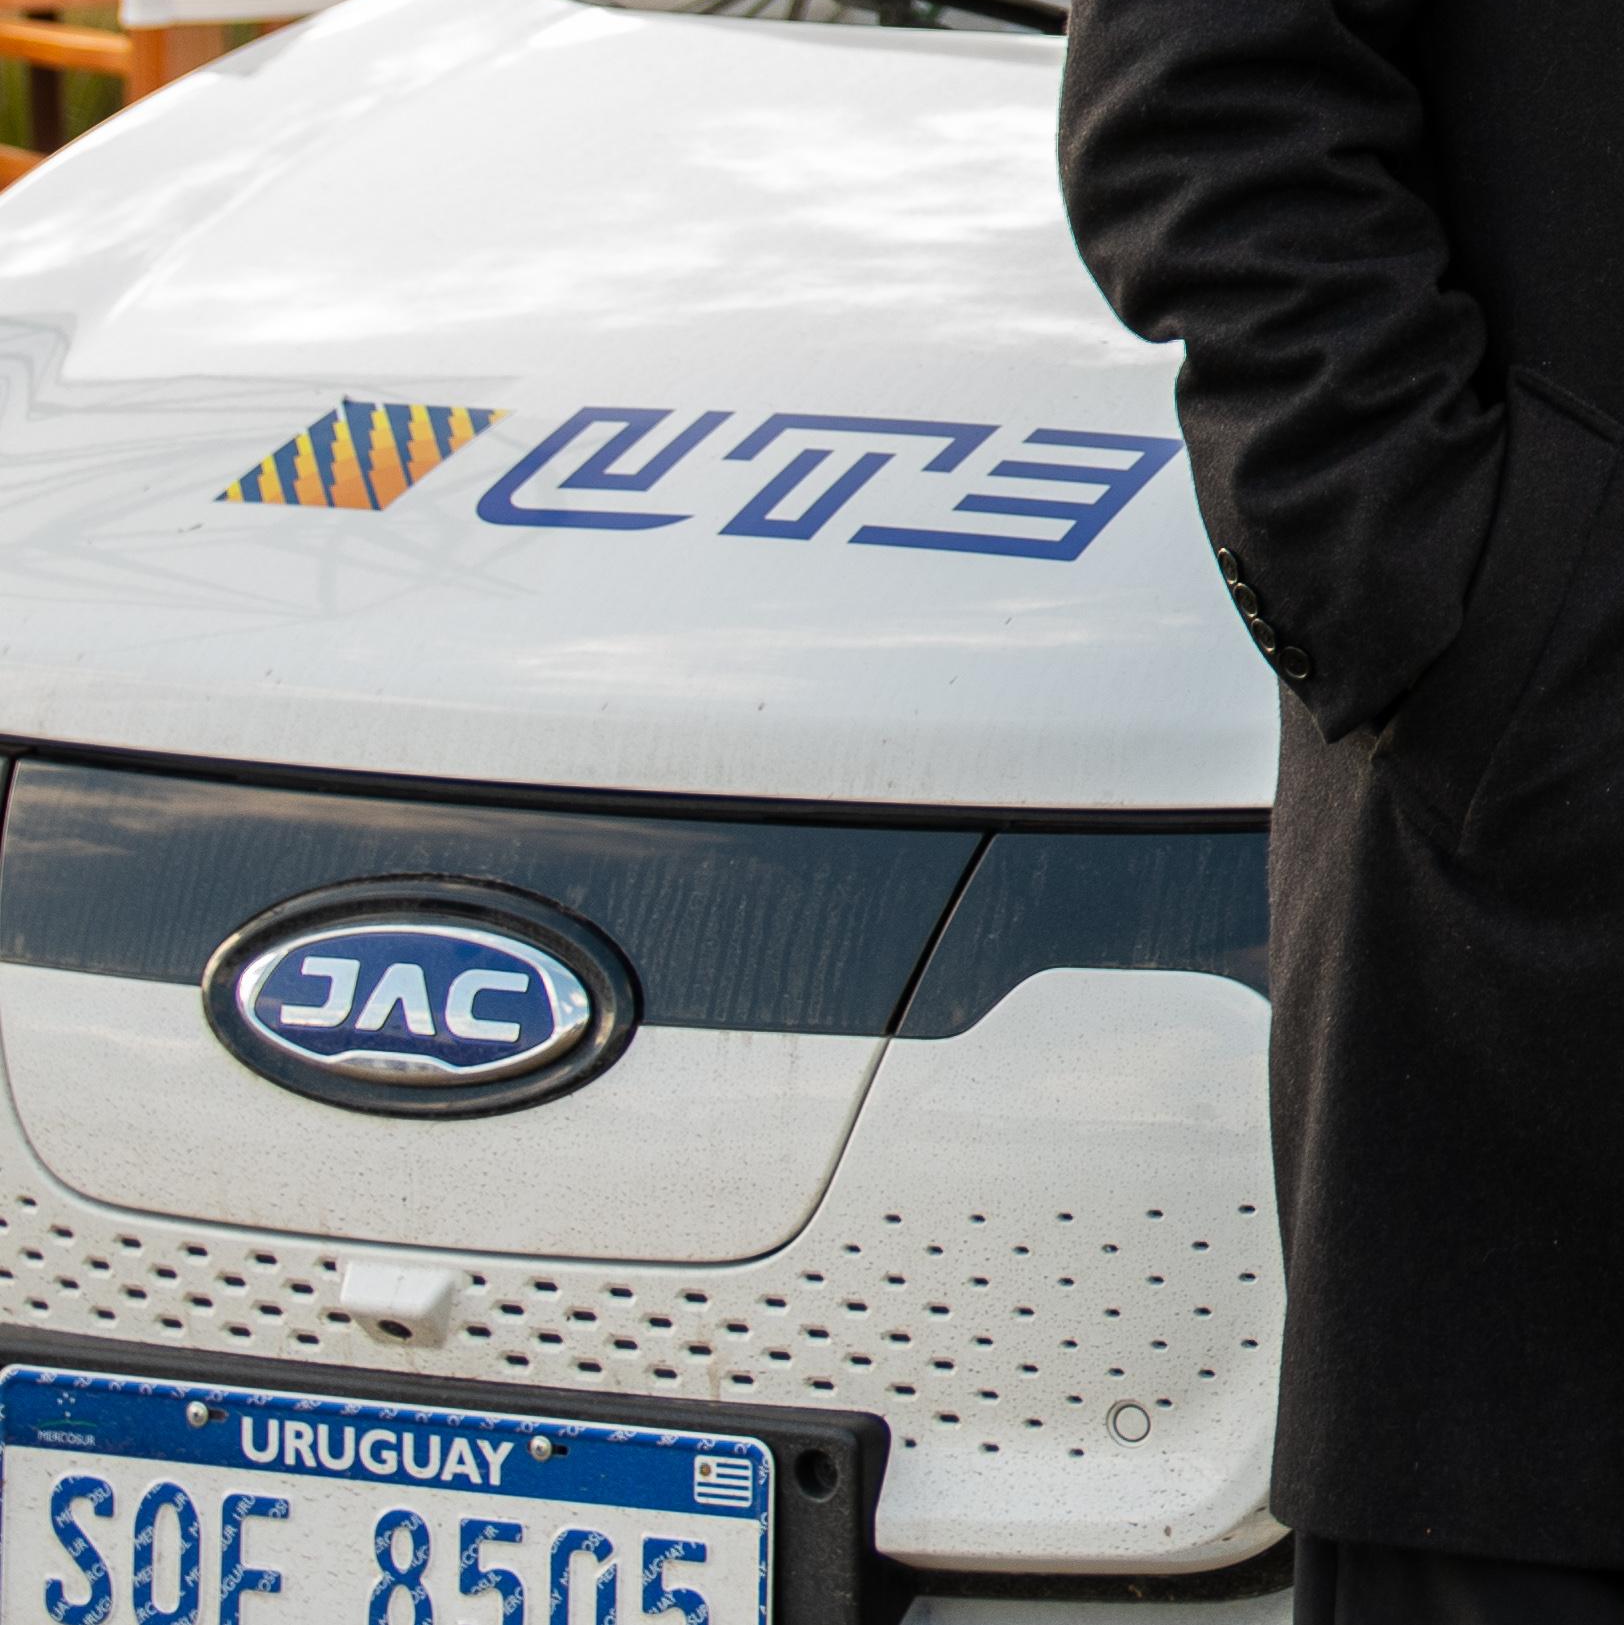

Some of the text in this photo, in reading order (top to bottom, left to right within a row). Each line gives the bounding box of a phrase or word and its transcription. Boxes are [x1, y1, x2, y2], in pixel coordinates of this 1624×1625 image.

[475, 406, 1184, 561] UTE
[280, 955, 529, 1043] JAC
[240, 1415, 514, 1486] URUGUAY
[367, 1508, 709, 1625] 8505
